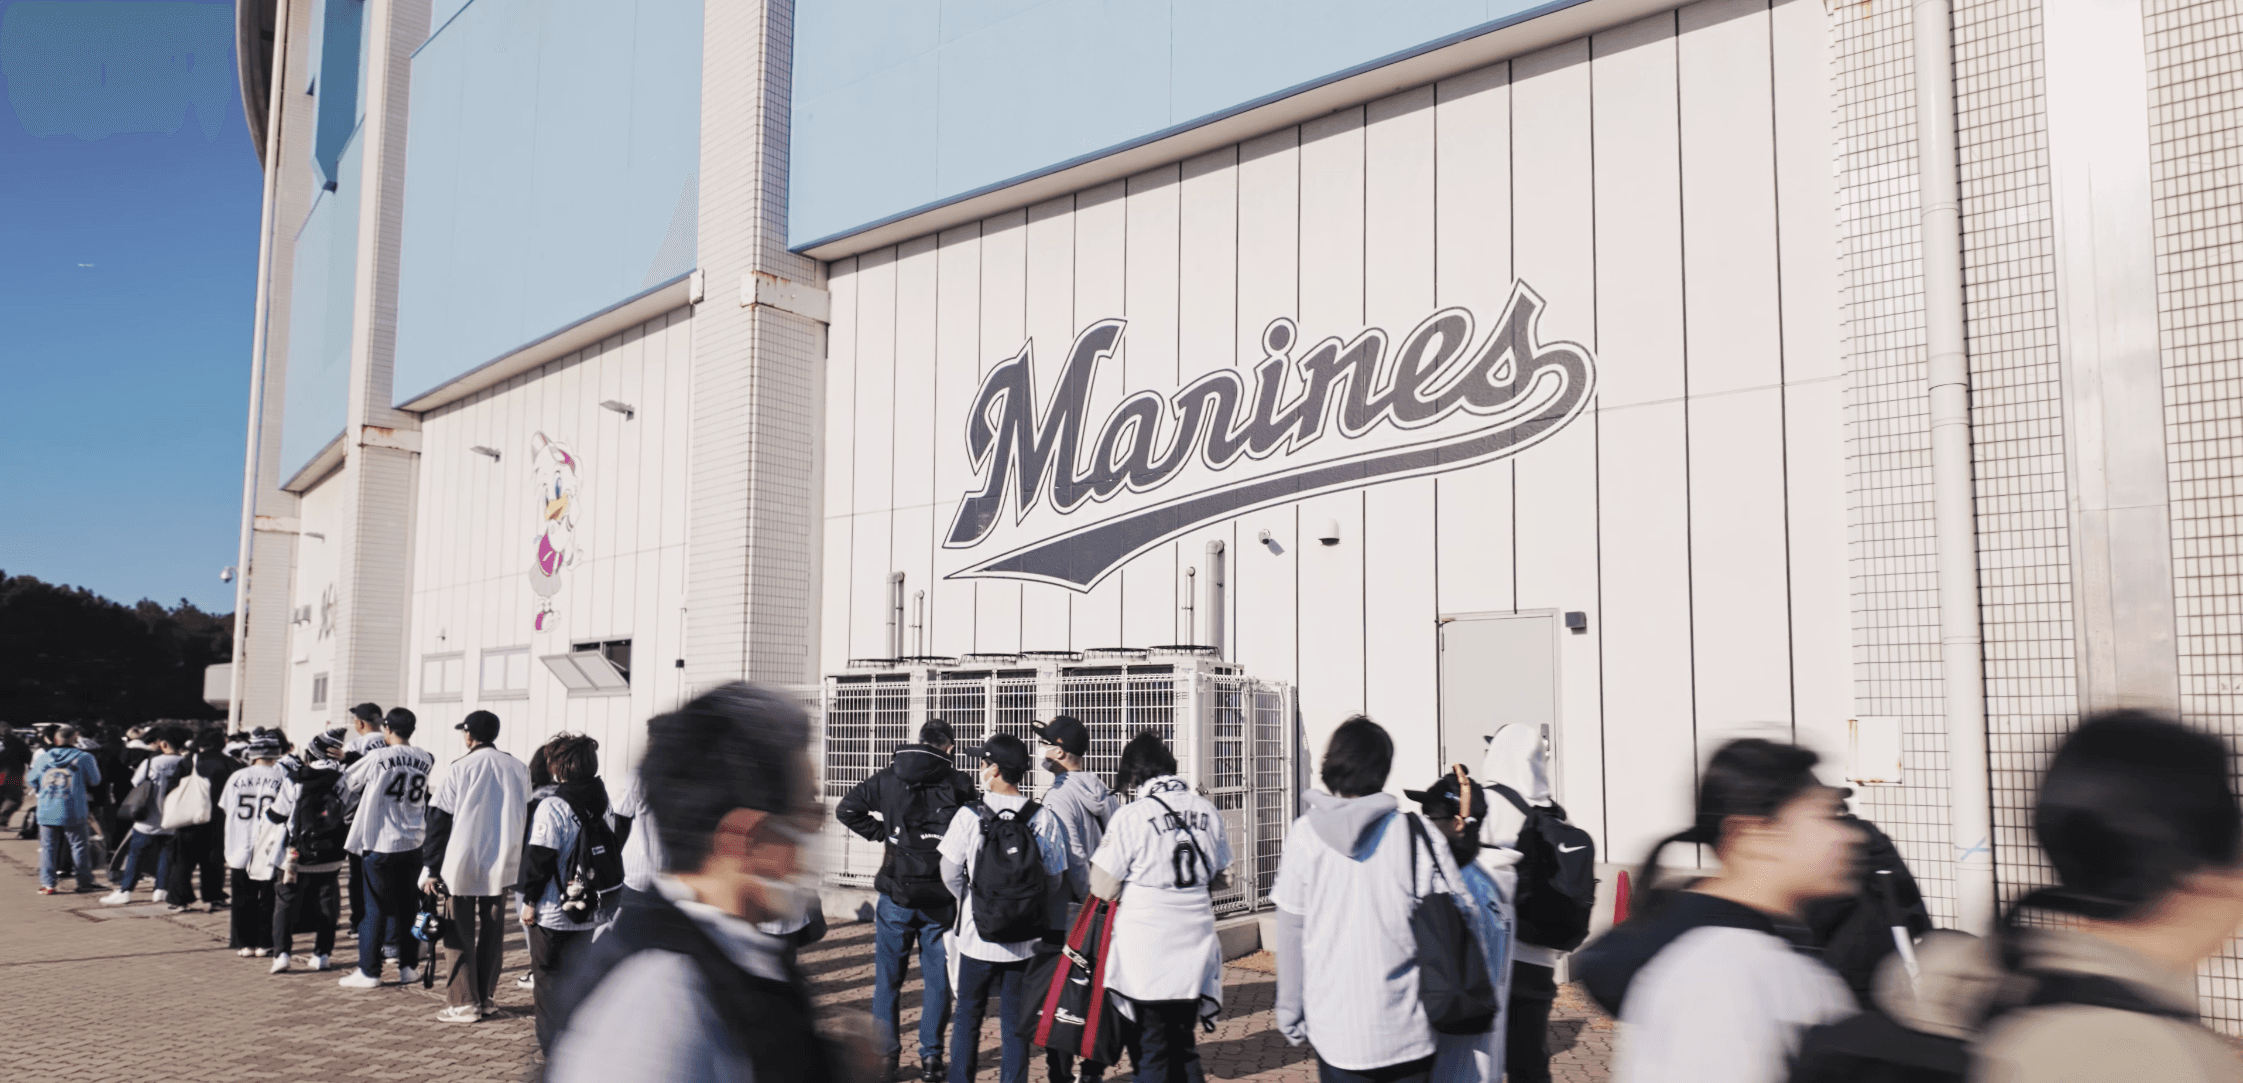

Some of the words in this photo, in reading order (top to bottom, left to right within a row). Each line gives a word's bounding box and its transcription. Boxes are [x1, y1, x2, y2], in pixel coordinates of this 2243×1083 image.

[943, 278, 1596, 593] Marines
[384, 772, 426, 803] 48
[1148, 810, 1209, 836] T.OINO
[1173, 840, 1196, 889] 0
